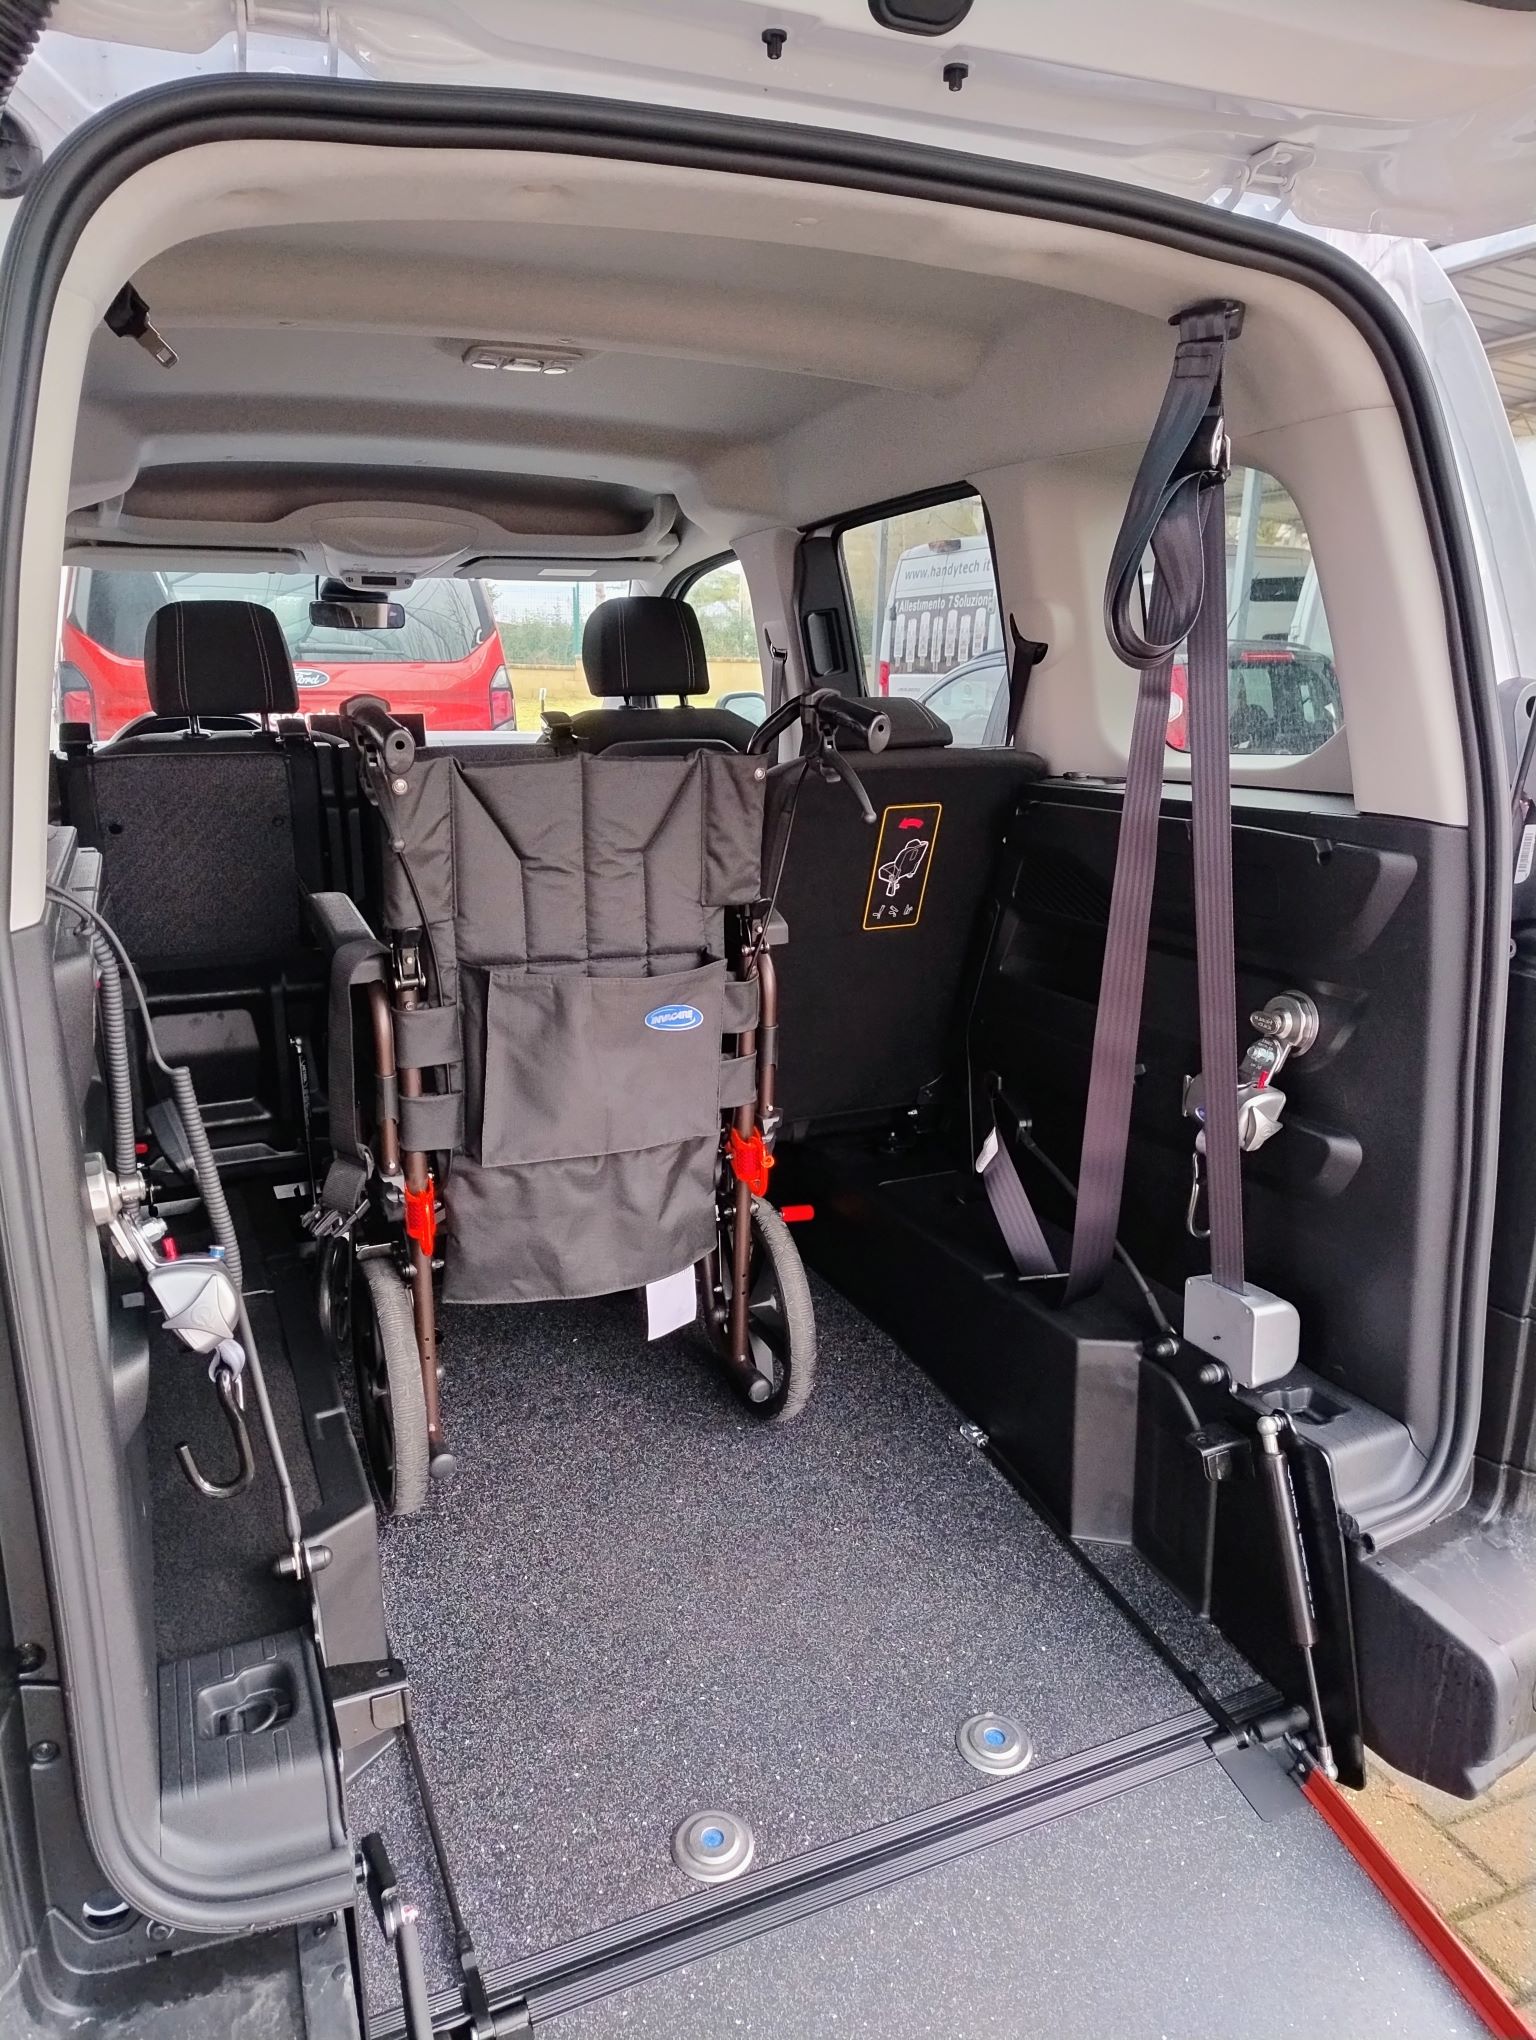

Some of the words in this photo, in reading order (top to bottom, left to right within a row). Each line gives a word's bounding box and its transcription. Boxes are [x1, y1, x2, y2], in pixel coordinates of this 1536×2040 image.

[905, 559, 991, 580] www.handytechit
[899, 597, 945, 613] Allestimento
[948, 596, 954, 608] 7
